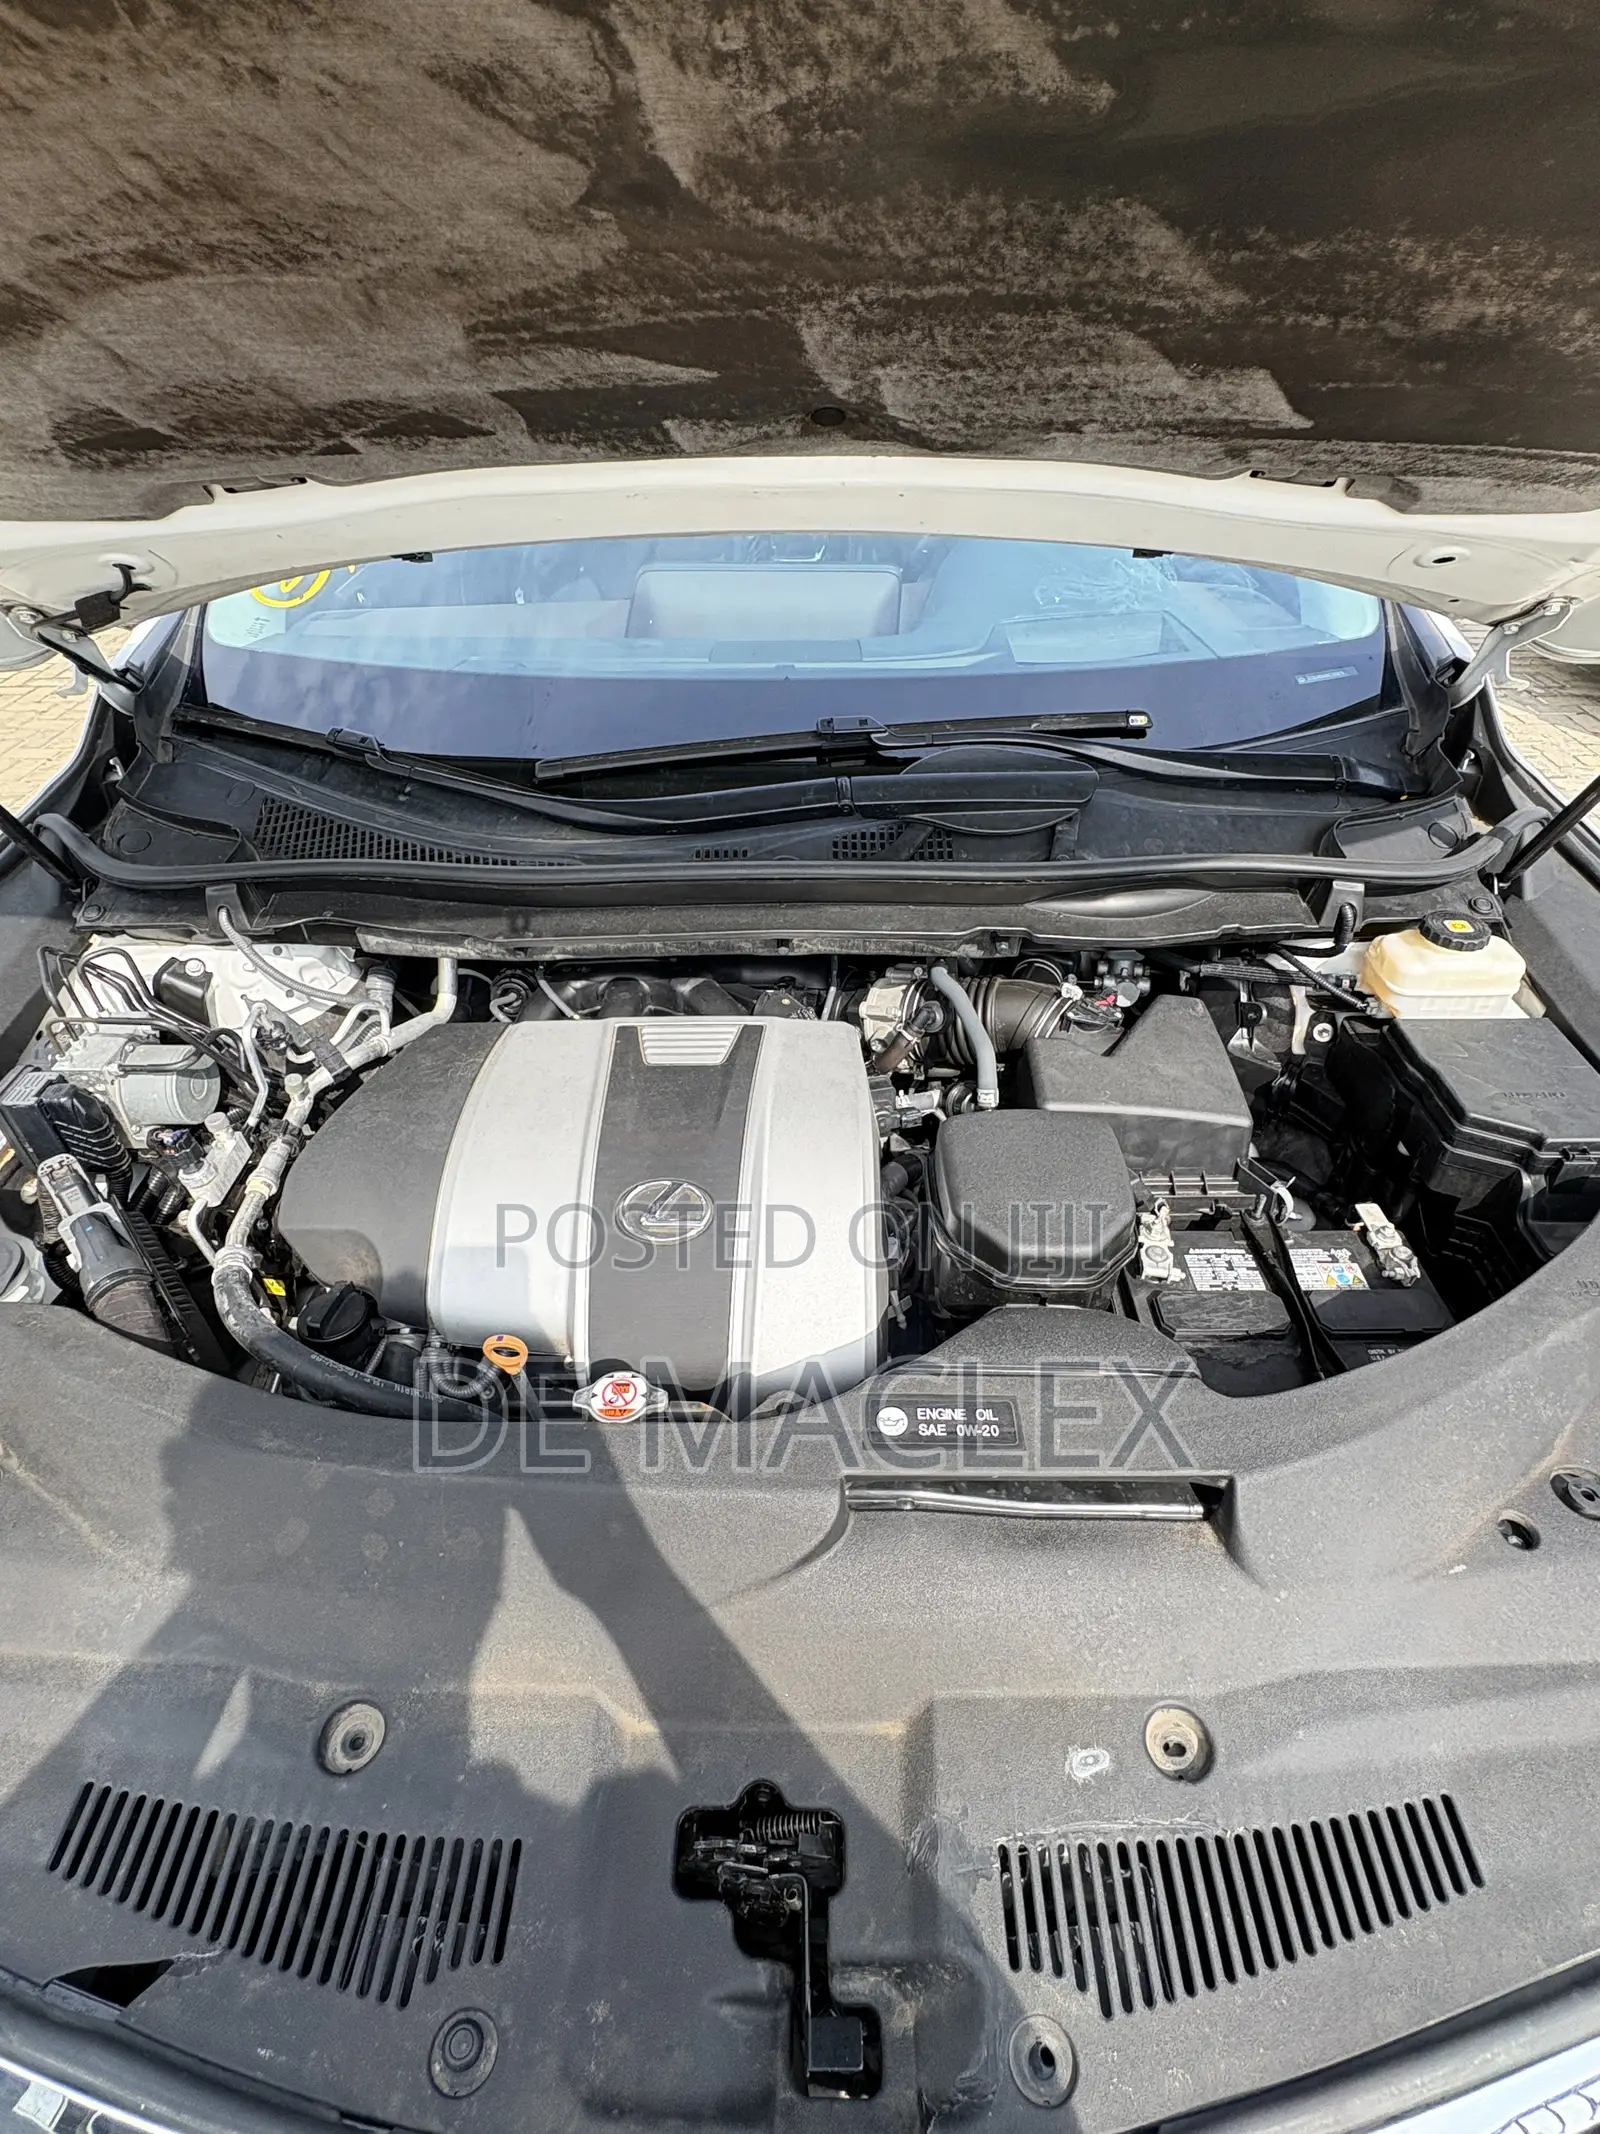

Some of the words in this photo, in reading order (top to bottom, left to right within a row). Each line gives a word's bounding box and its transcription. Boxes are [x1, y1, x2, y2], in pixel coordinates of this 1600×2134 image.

[916, 1407, 967, 1421] ENGINE
[975, 1408, 999, 1421] OIL
[918, 1423, 947, 1436] SAE
[956, 1424, 1000, 1437] 0W-20
